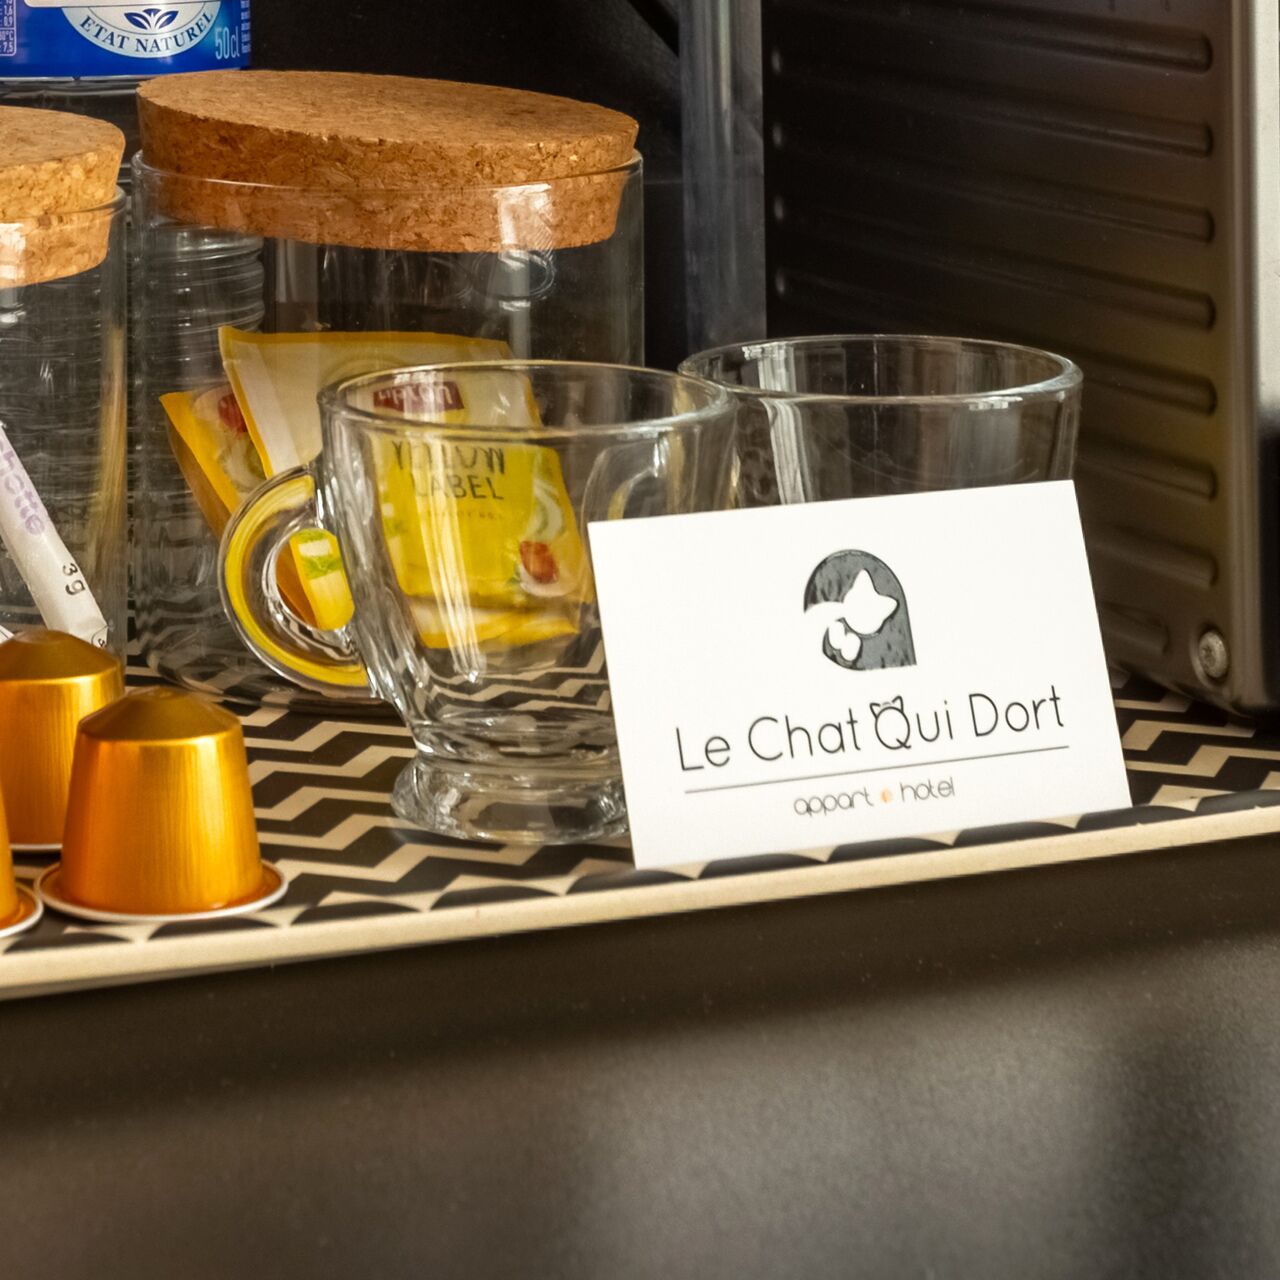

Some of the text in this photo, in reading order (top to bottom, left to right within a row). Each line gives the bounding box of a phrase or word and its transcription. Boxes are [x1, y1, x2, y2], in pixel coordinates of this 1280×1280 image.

[79, 11, 214, 53] ETAT NATUREL
[214, 26, 241, 60] 50cl
[409, 473, 504, 501] LABEL
[675, 684, 1066, 772] Le Chat Qui Dort
[792, 776, 956, 819] appart hotel
